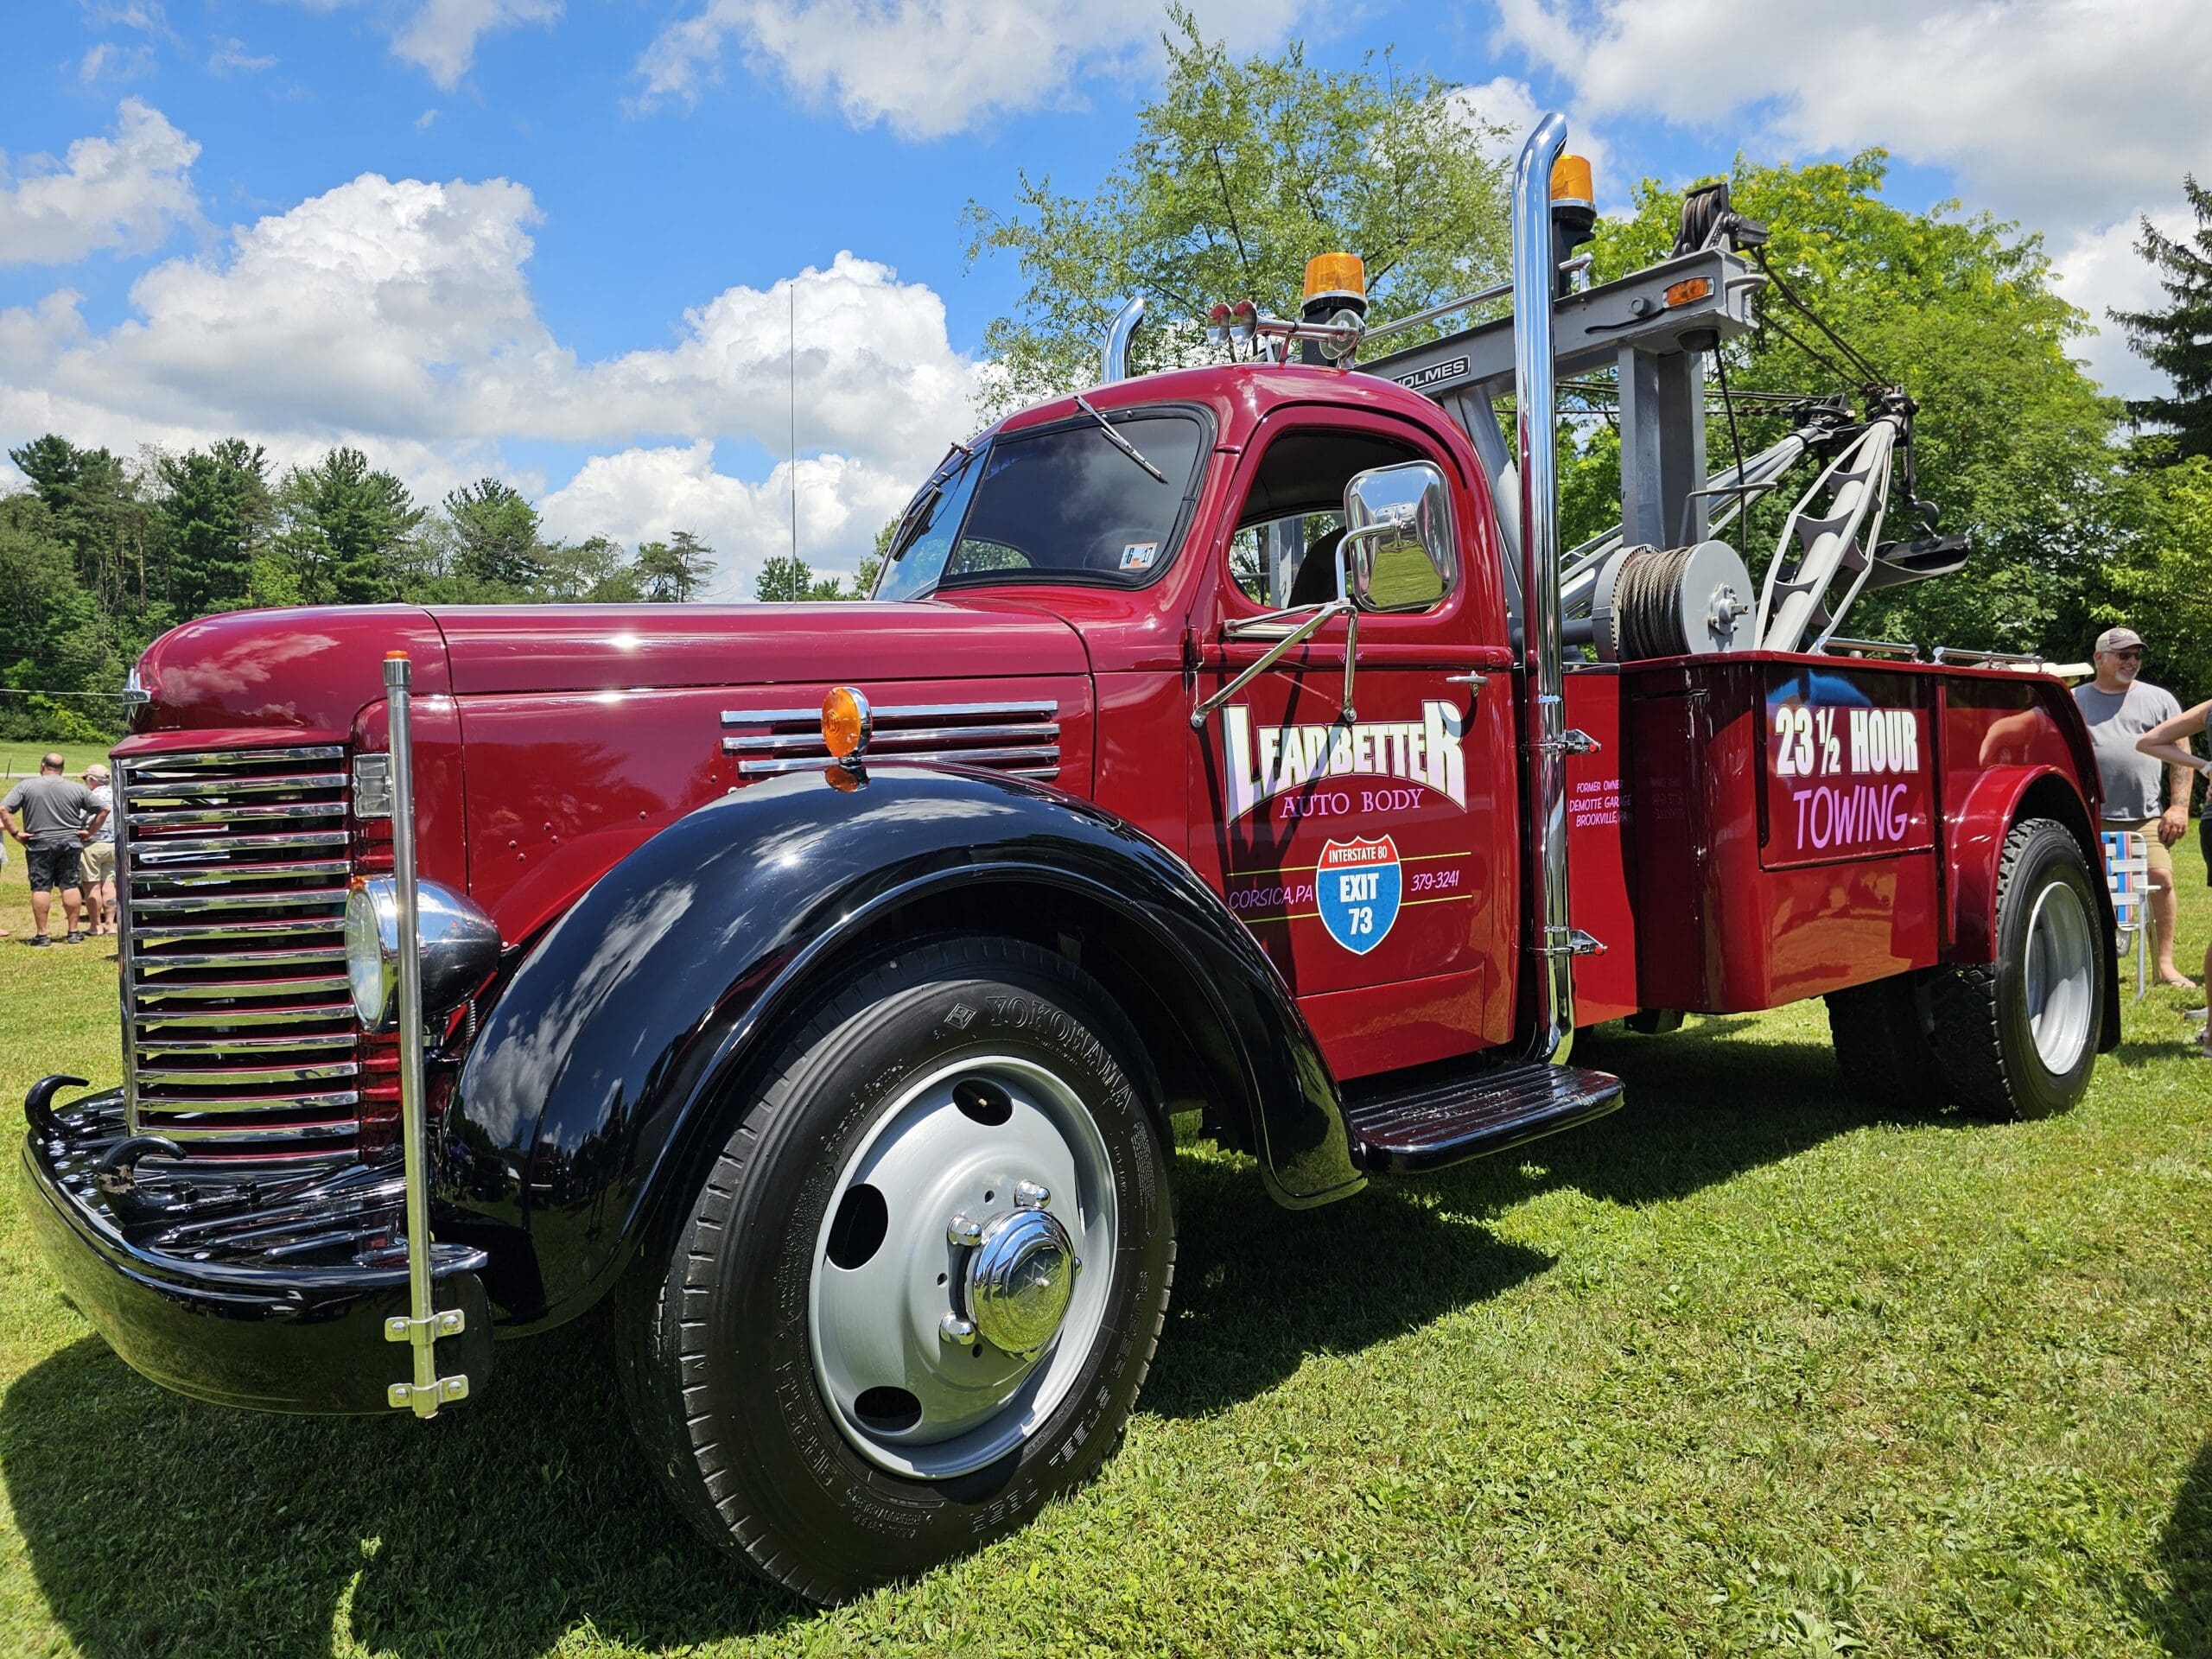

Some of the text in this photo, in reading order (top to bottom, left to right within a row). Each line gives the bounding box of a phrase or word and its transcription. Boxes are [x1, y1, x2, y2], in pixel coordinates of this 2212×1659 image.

[1399, 360, 1465, 388] OLMES
[1849, 707, 1919, 773] HOUR
[1219, 700, 1468, 829] LEADBETTER
[1577, 781, 1600, 793] FORMER
[1280, 789, 1425, 818] AUTO BODY
[1569, 798, 1602, 813] DEMOTTE
[1792, 784, 1908, 850] TOWING
[1329, 846, 1388, 863] INTERSTATE 80
[1340, 873, 1380, 903] EXIT
[1410, 870, 1460, 892] 379-3241
[1348, 906, 1374, 935] 73
[985, 995, 1133, 1116] YOKOHAMA
